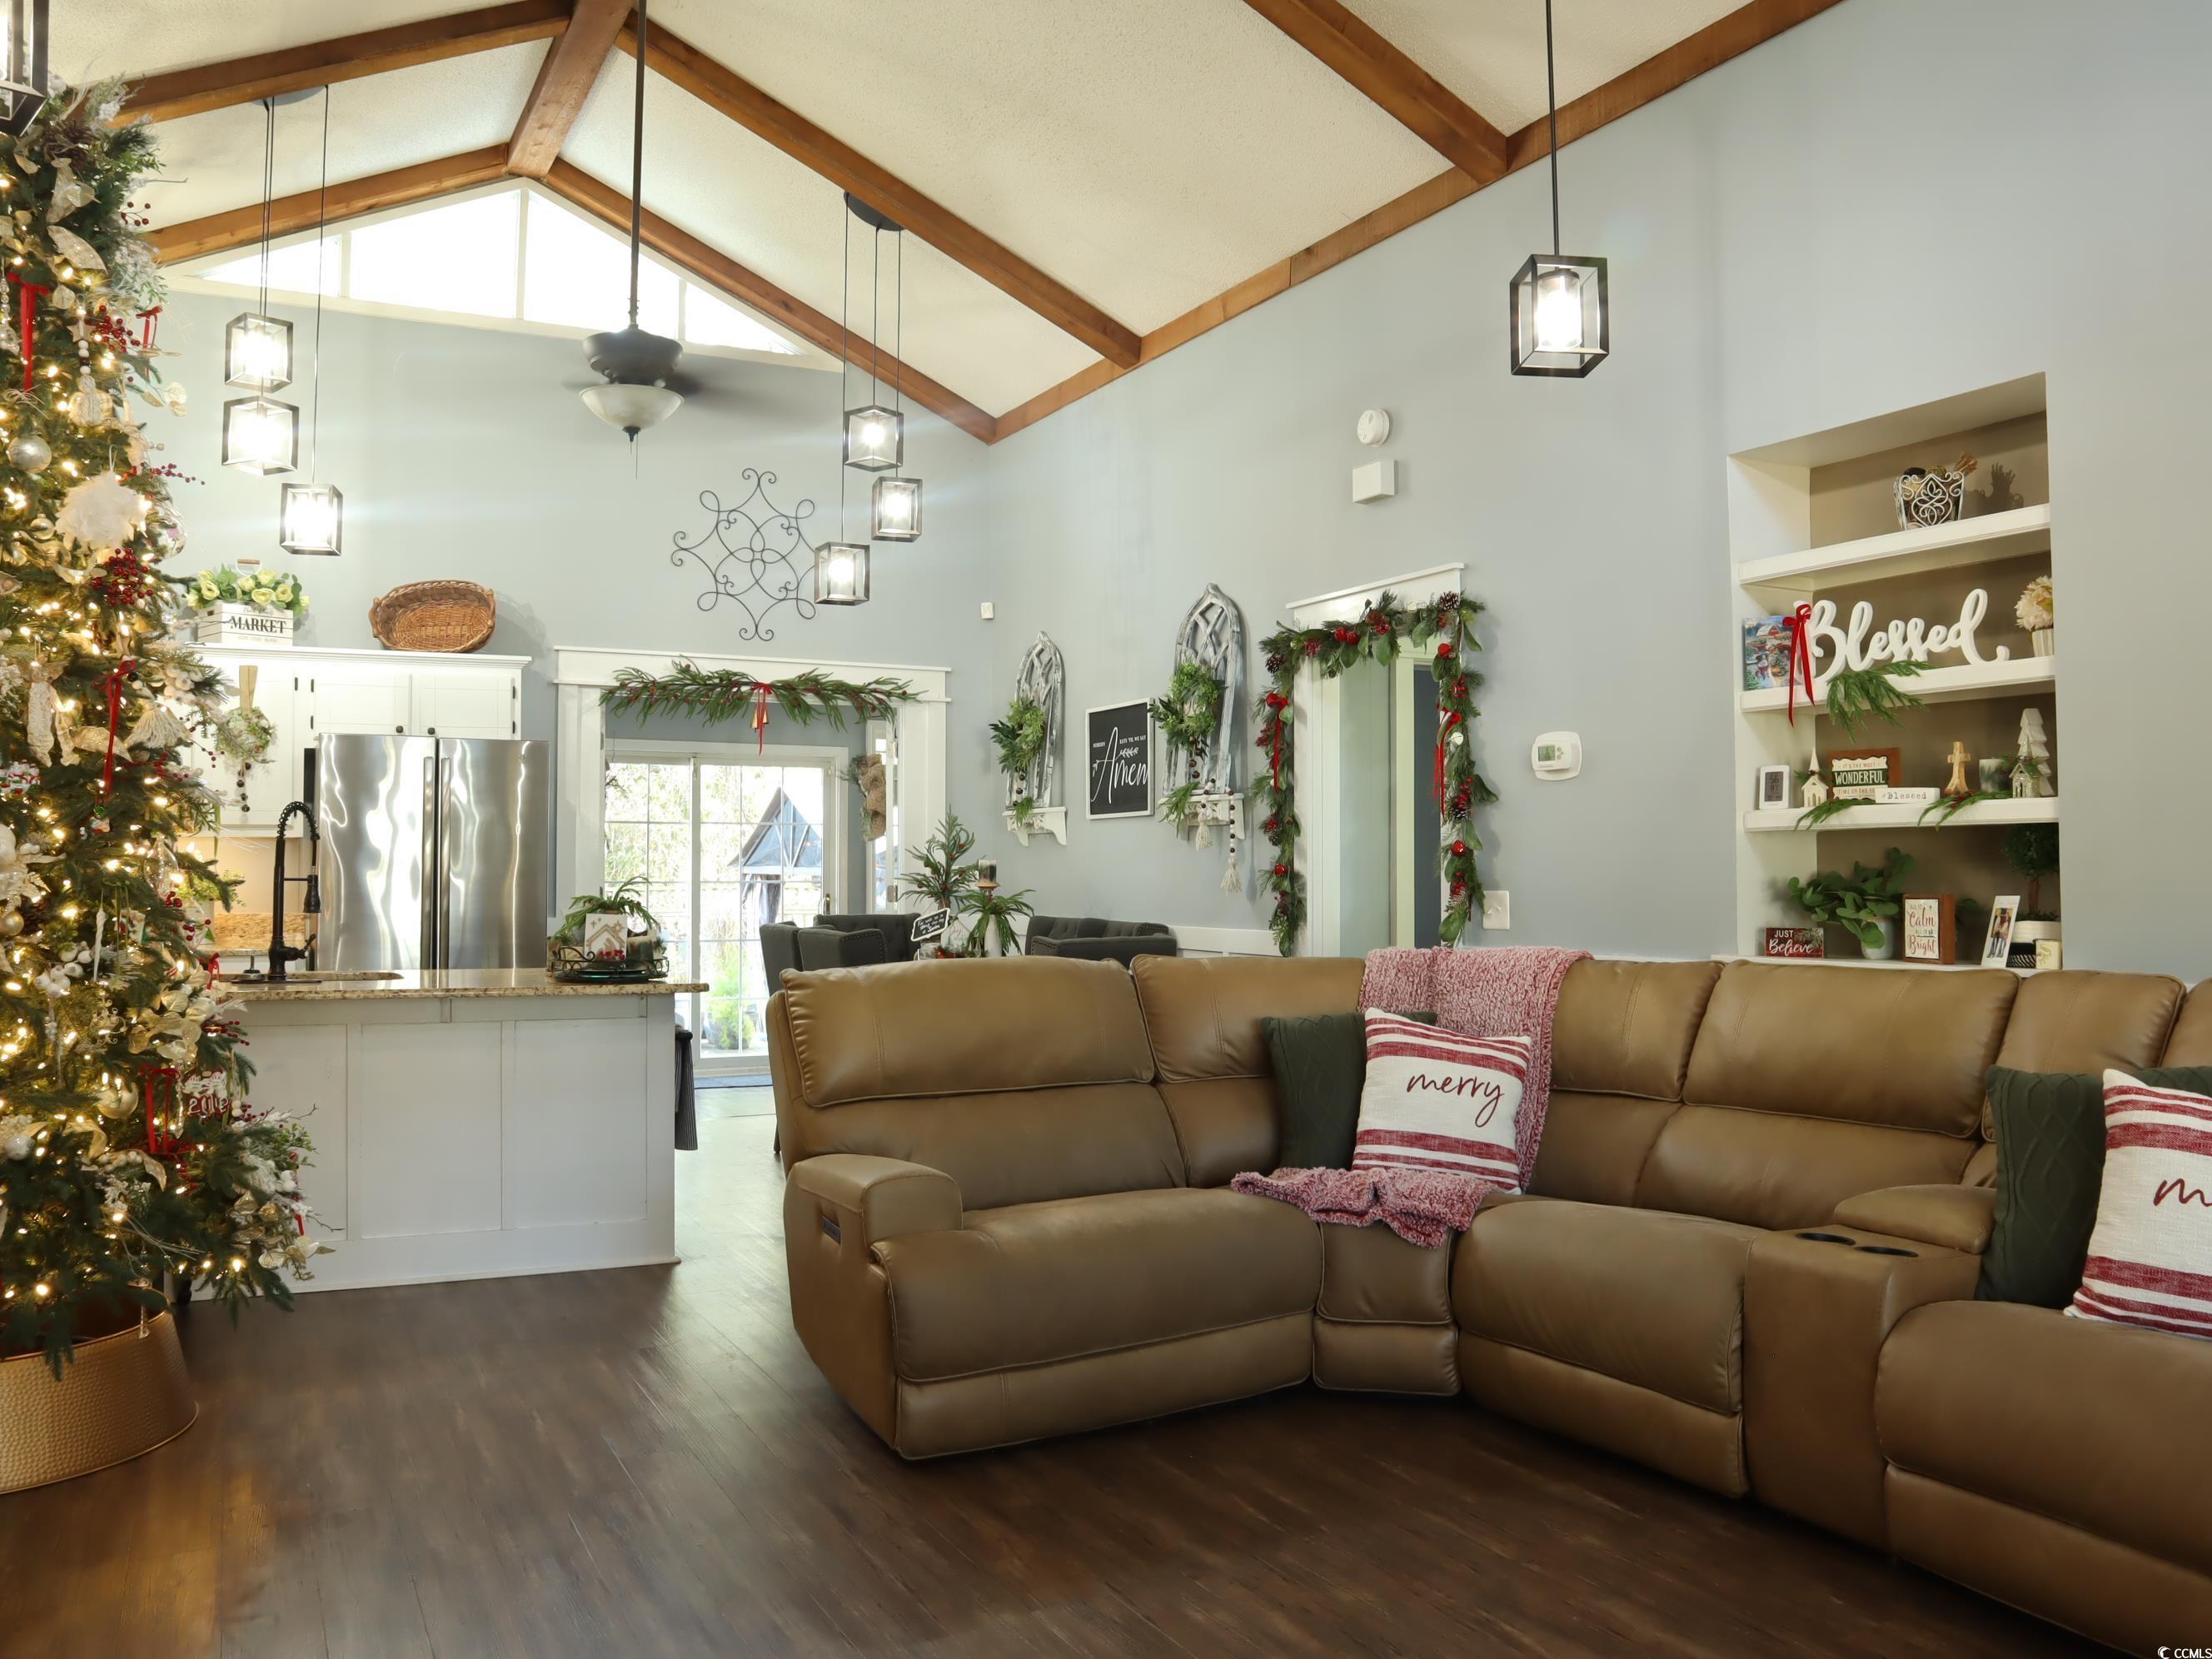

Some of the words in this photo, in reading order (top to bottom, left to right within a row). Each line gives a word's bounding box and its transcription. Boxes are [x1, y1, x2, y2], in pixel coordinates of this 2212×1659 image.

[230, 615, 286, 634] MARKET
[1793, 589, 2010, 683] Blessed
[1090, 726, 1148, 804] Amen
[1835, 770, 1885, 785] WONDERFUL
[1907, 906, 1935, 927] Calm
[1774, 929, 1794, 938] JUST
[1769, 939, 1813, 956] Believe
[1908, 934, 1936, 954] Bright
[1406, 1074, 1505, 1128] merry
[2153, 1178, 2212, 1207] m
